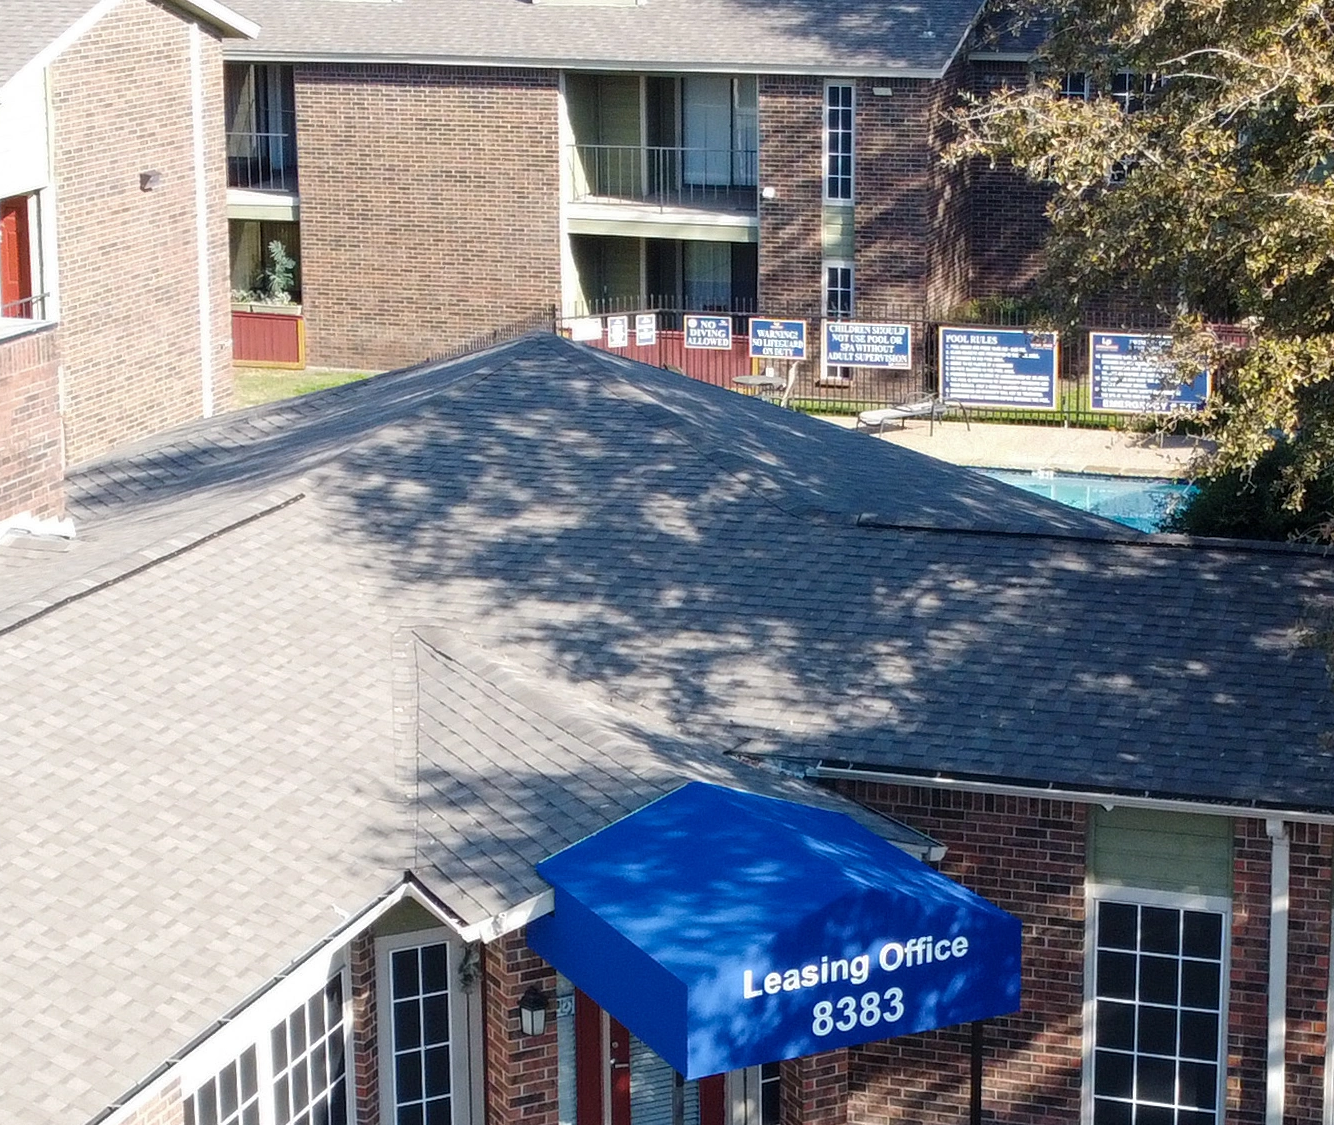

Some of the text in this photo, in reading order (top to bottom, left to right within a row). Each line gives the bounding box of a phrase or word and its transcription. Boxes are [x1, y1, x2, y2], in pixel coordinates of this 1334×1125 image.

[701, 320, 716, 329] NO
[689, 329, 726, 338] DIVING
[829, 325, 905, 335] CHILDREN SHOULD
[687, 337, 728, 346] ALLOWED
[832, 333, 903, 344] NOT USE POOL OR
[945, 335, 998, 344] POOL RULES
[753, 339, 803, 349] NO LIFEGUARD
[840, 343, 895, 353] SPA WITHOUT
[762, 347, 773, 355] ON
[828, 352, 907, 362] ADULT SUPERVISION
[743, 936, 969, 999] Leasing Office
[812, 987, 904, 1036] 8383
